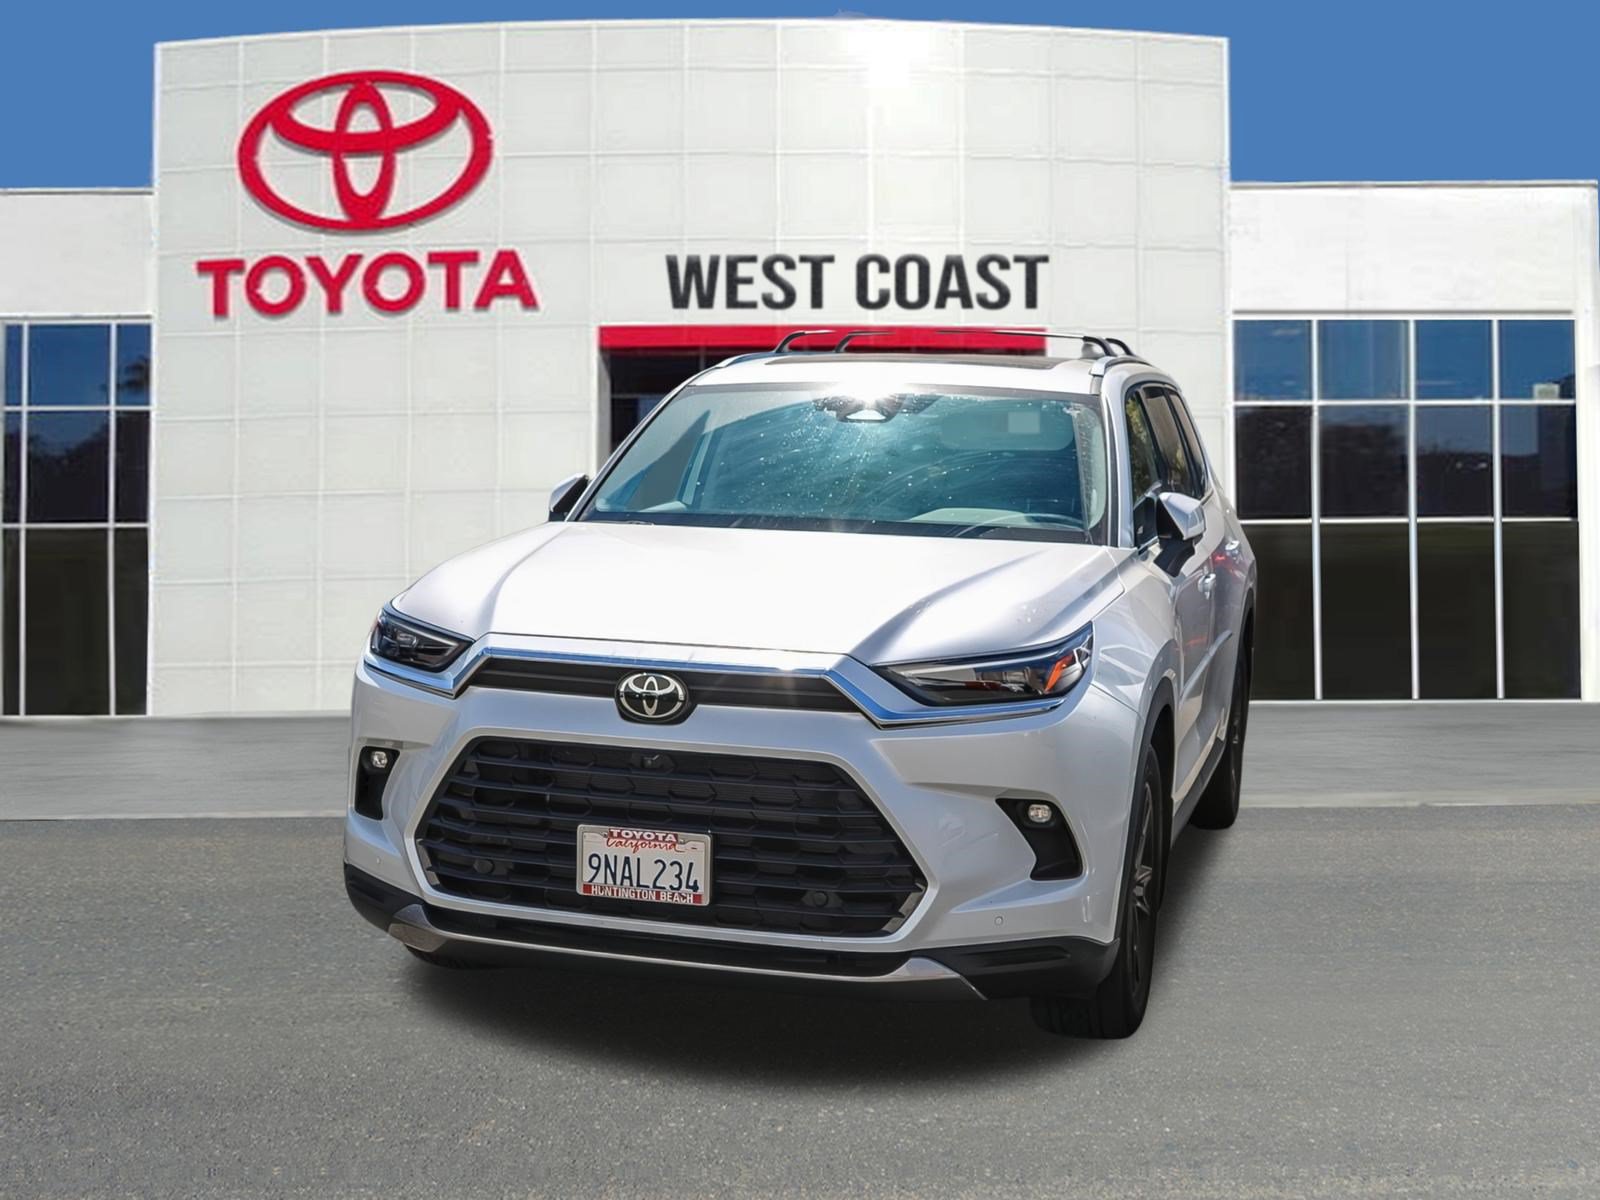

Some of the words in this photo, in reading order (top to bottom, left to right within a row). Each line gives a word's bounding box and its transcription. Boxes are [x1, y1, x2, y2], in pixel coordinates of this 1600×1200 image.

[196, 249, 540, 317] TOYOTA
[665, 253, 835, 311] WEST
[855, 253, 1049, 311] COAST
[610, 829, 677, 843] TOYOTA
[588, 853, 700, 892] 9NAL234
[591, 885, 656, 900] HUNTINGTON
[659, 892, 694, 904] BEACH
